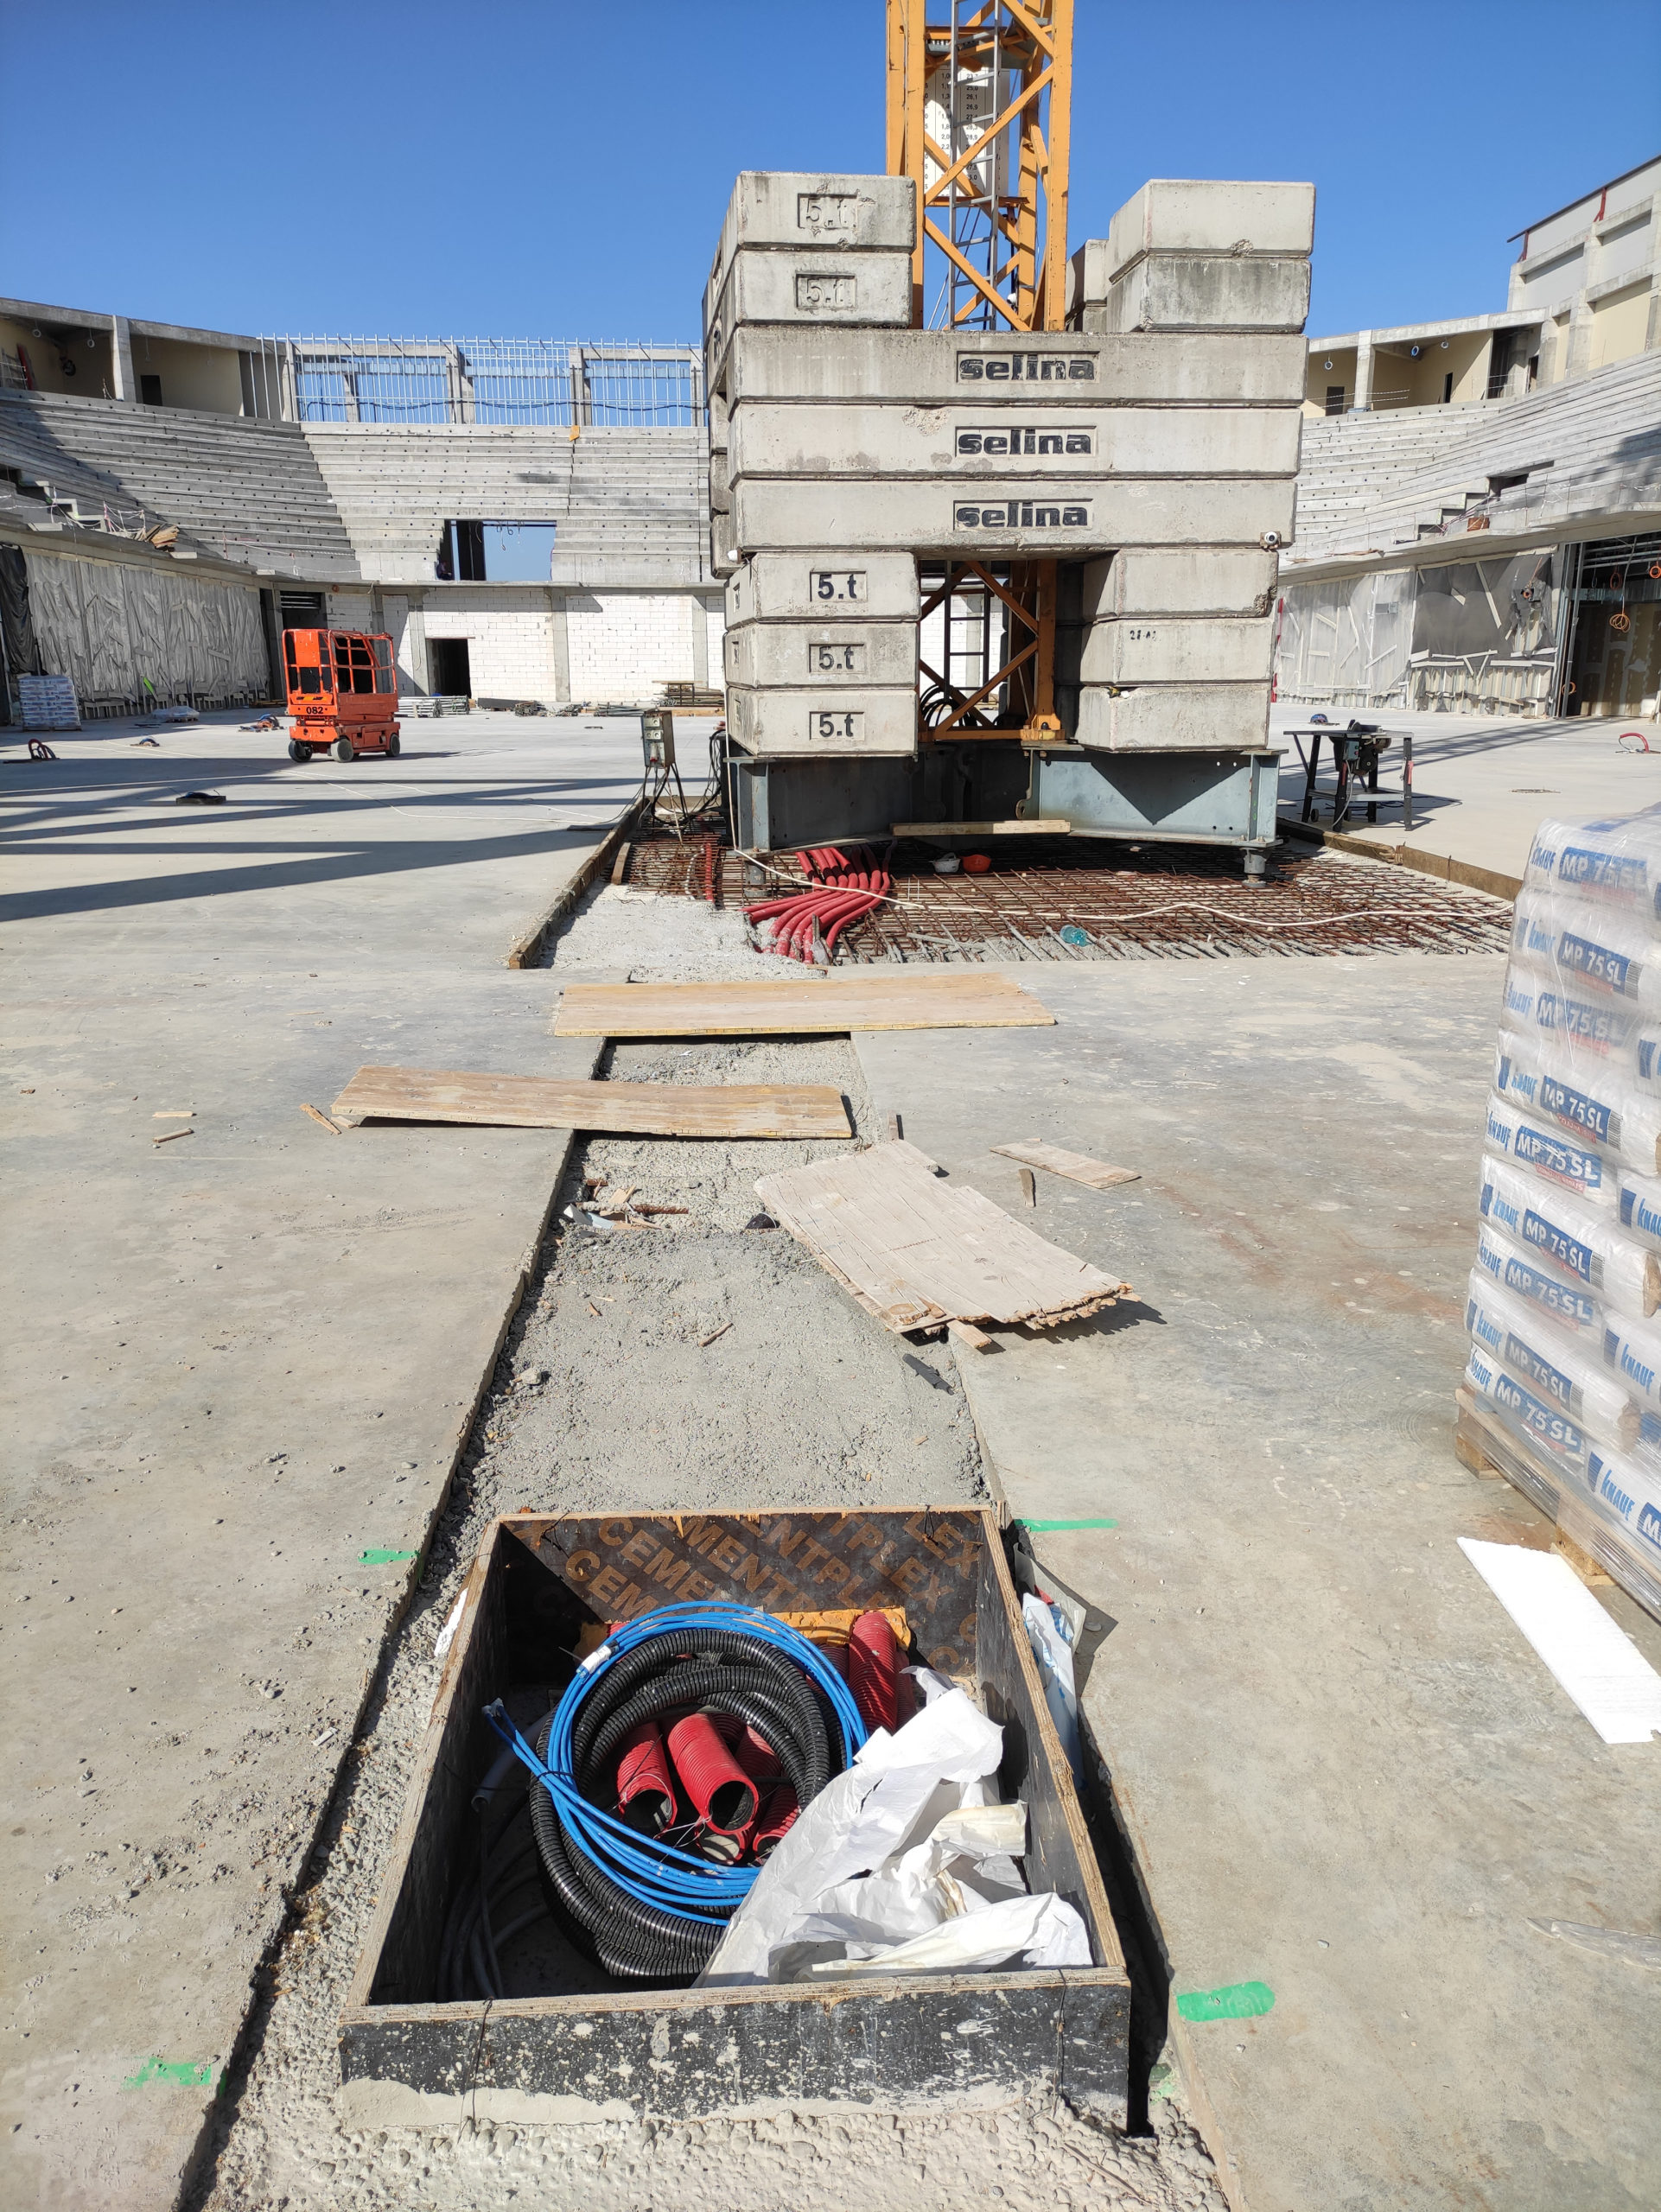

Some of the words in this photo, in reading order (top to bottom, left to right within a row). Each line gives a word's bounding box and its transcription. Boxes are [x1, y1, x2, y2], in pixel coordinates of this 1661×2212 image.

[959, 354, 1095, 380] selina
[958, 429, 1091, 455] selina
[956, 502, 1088, 528] selina
[818, 574, 857, 600] 5.t
[818, 645, 854, 670] 5.t
[306, 706, 324, 715] 082
[819, 714, 854, 738] 5.t
[1562, 854, 1588, 880] MP
[1561, 940, 1585, 964] MP
[1586, 953, 1606, 977] 75
[1569, 1008, 1592, 1034] 75
[1543, 1083, 1565, 1109] MP
[1569, 1097, 1586, 1123] 75
[1587, 1107, 1604, 1135] SL
[1487, 1110, 1511, 1152] KNAUF
[1517, 1133, 1543, 1160] MP
[1545, 1147, 1567, 1172] 75
[1569, 1155, 1599, 1181] SL
[1493, 1192, 1519, 1234] KNAUF
[1525, 1217, 1547, 1243] MP
[1551, 1235, 1568, 1262] 75
[1569, 1245, 1587, 1274] SL
[1507, 1267, 1532, 1291] MP
[1537, 1282, 1559, 1308] 75
[1561, 1294, 1591, 1320] SL
[1476, 1309, 1503, 1354] KNAUF
[1507, 1340, 1529, 1368] MP
[1532, 1361, 1549, 1387] 75
[1550, 1377, 1568, 1403] SL
[1620, 1343, 1656, 1395] KNAUF
[1497, 1382, 1521, 1408] MP
[1525, 1401, 1548, 1432] 75
[1549, 1419, 1578, 1447] SL
[1600, 1469, 1636, 1522] KNAUF
